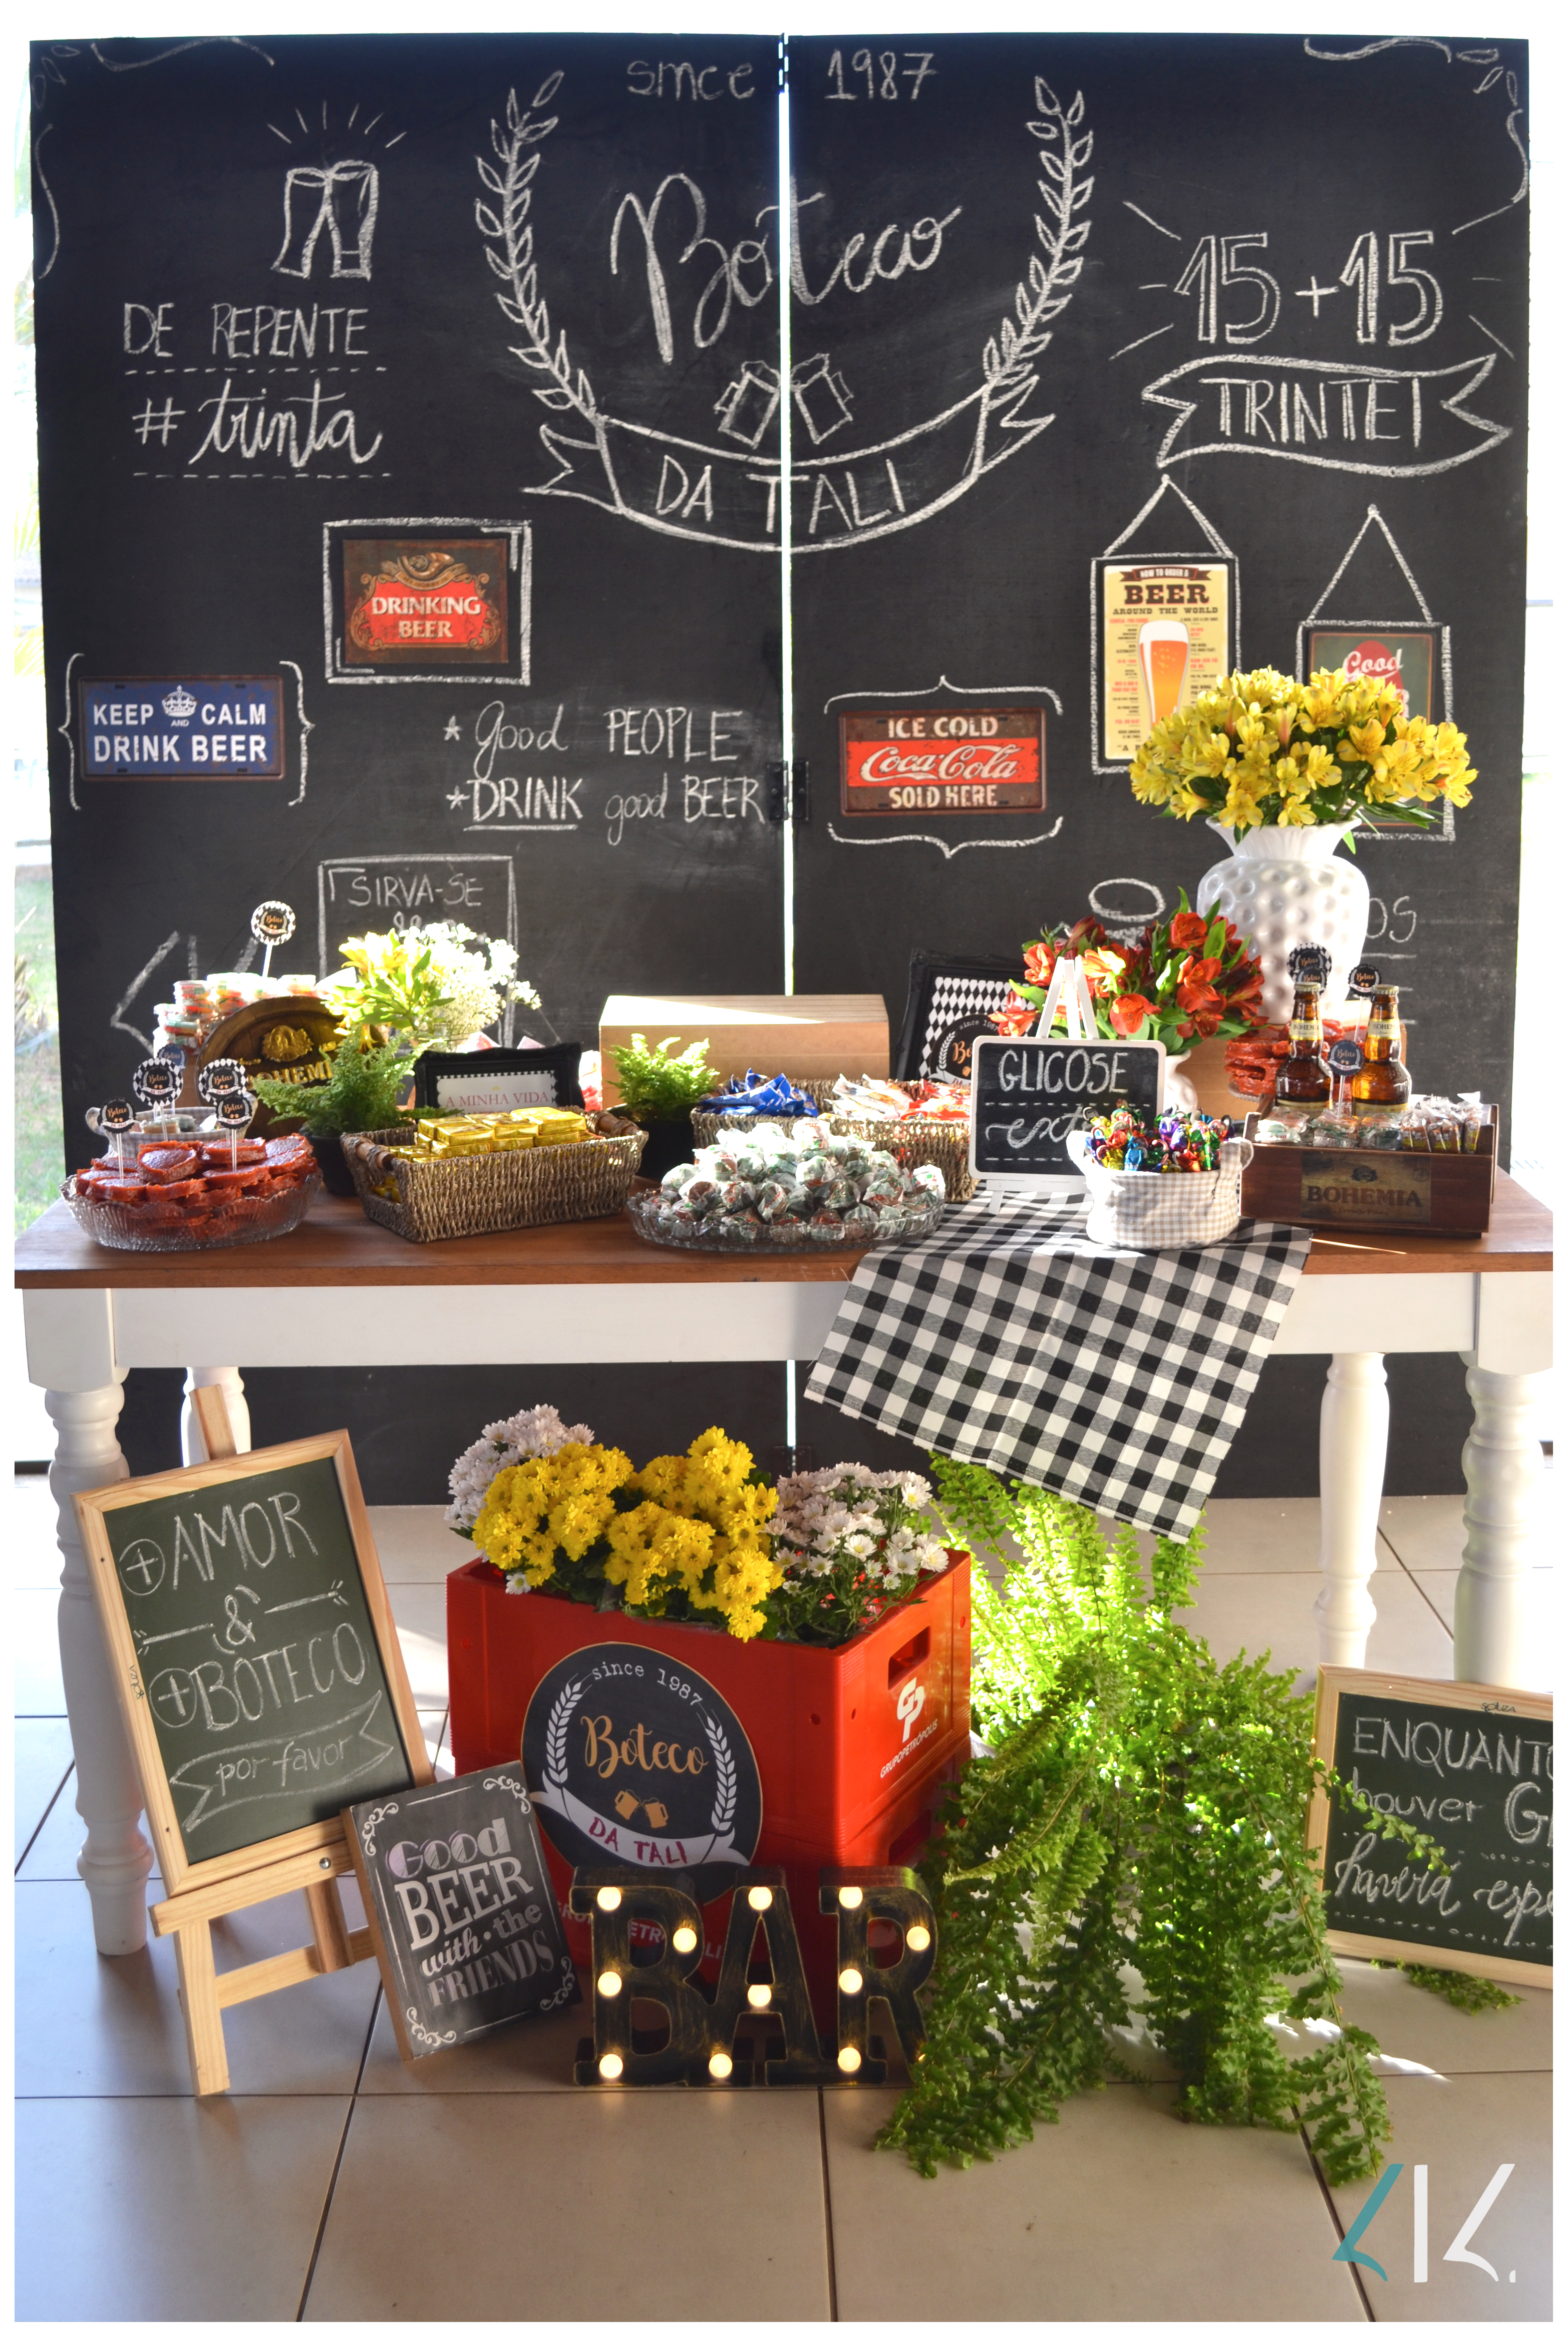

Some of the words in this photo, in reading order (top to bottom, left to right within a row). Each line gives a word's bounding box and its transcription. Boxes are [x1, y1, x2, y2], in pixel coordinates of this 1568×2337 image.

[824, 49, 938, 101] 1987
[611, 173, 961, 363] Boteco
[1173, 232, 1280, 345] 15
[1340, 231, 1443, 346] 15
[125, 303, 174, 357] DE
[212, 303, 369, 358] REPENTE
[657, 455, 712, 521] DA
[747, 458, 904, 534] TALI
[372, 596, 481, 615] DRINKING
[1124, 584, 1209, 604] BEER
[399, 620, 454, 638] BEER
[1343, 648, 1404, 678] Good
[94, 704, 154, 726] KEEP
[201, 703, 266, 725] CALM
[171, 719, 189, 727] AND
[603, 707, 743, 763] PEOPLE
[888, 718, 925, 738] ICE
[934, 717, 998, 737] COLD
[94, 735, 179, 762] DRINK
[191, 735, 267, 762] BEER
[860, 744, 1023, 782] Coca-Cola
[467, 776, 583, 822] DRINK
[604, 773, 668, 846] good
[681, 775, 766, 824] BEER
[889, 786, 940, 809] SOLD
[945, 785, 997, 806] HERE
[348, 872, 484, 907] SIRVA-SE
[960, 1020, 979, 1030] since
[998, 1049, 1128, 1094] GLICOSE
[446, 1097, 455, 1107] A
[459, 1094, 510, 1107] MINHA
[512, 1091, 549, 1103] VIDA
[1307, 1186, 1423, 1207] BOHEMIA
[172, 1491, 319, 1590] AMOR
[189, 1623, 367, 1731] BOTECO
[592, 1661, 645, 1681] since
[657, 1668, 703, 1706] 1987
[216, 1755, 269, 1796] por
[272, 1737, 352, 1787] favor
[580, 1715, 709, 1778] Boteco
[1352, 1767, 1484, 1822] houver
[385, 1817, 511, 1879] Good
[588, 1816, 618, 1852] DA
[634, 1840, 688, 1866] TALI
[394, 1856, 533, 1950] BEER
[420, 1927, 482, 1977] with
[494, 1904, 543, 1941] the
[427, 1929, 554, 2007] FRIENDS
[569, 1865, 937, 2087] BAR
